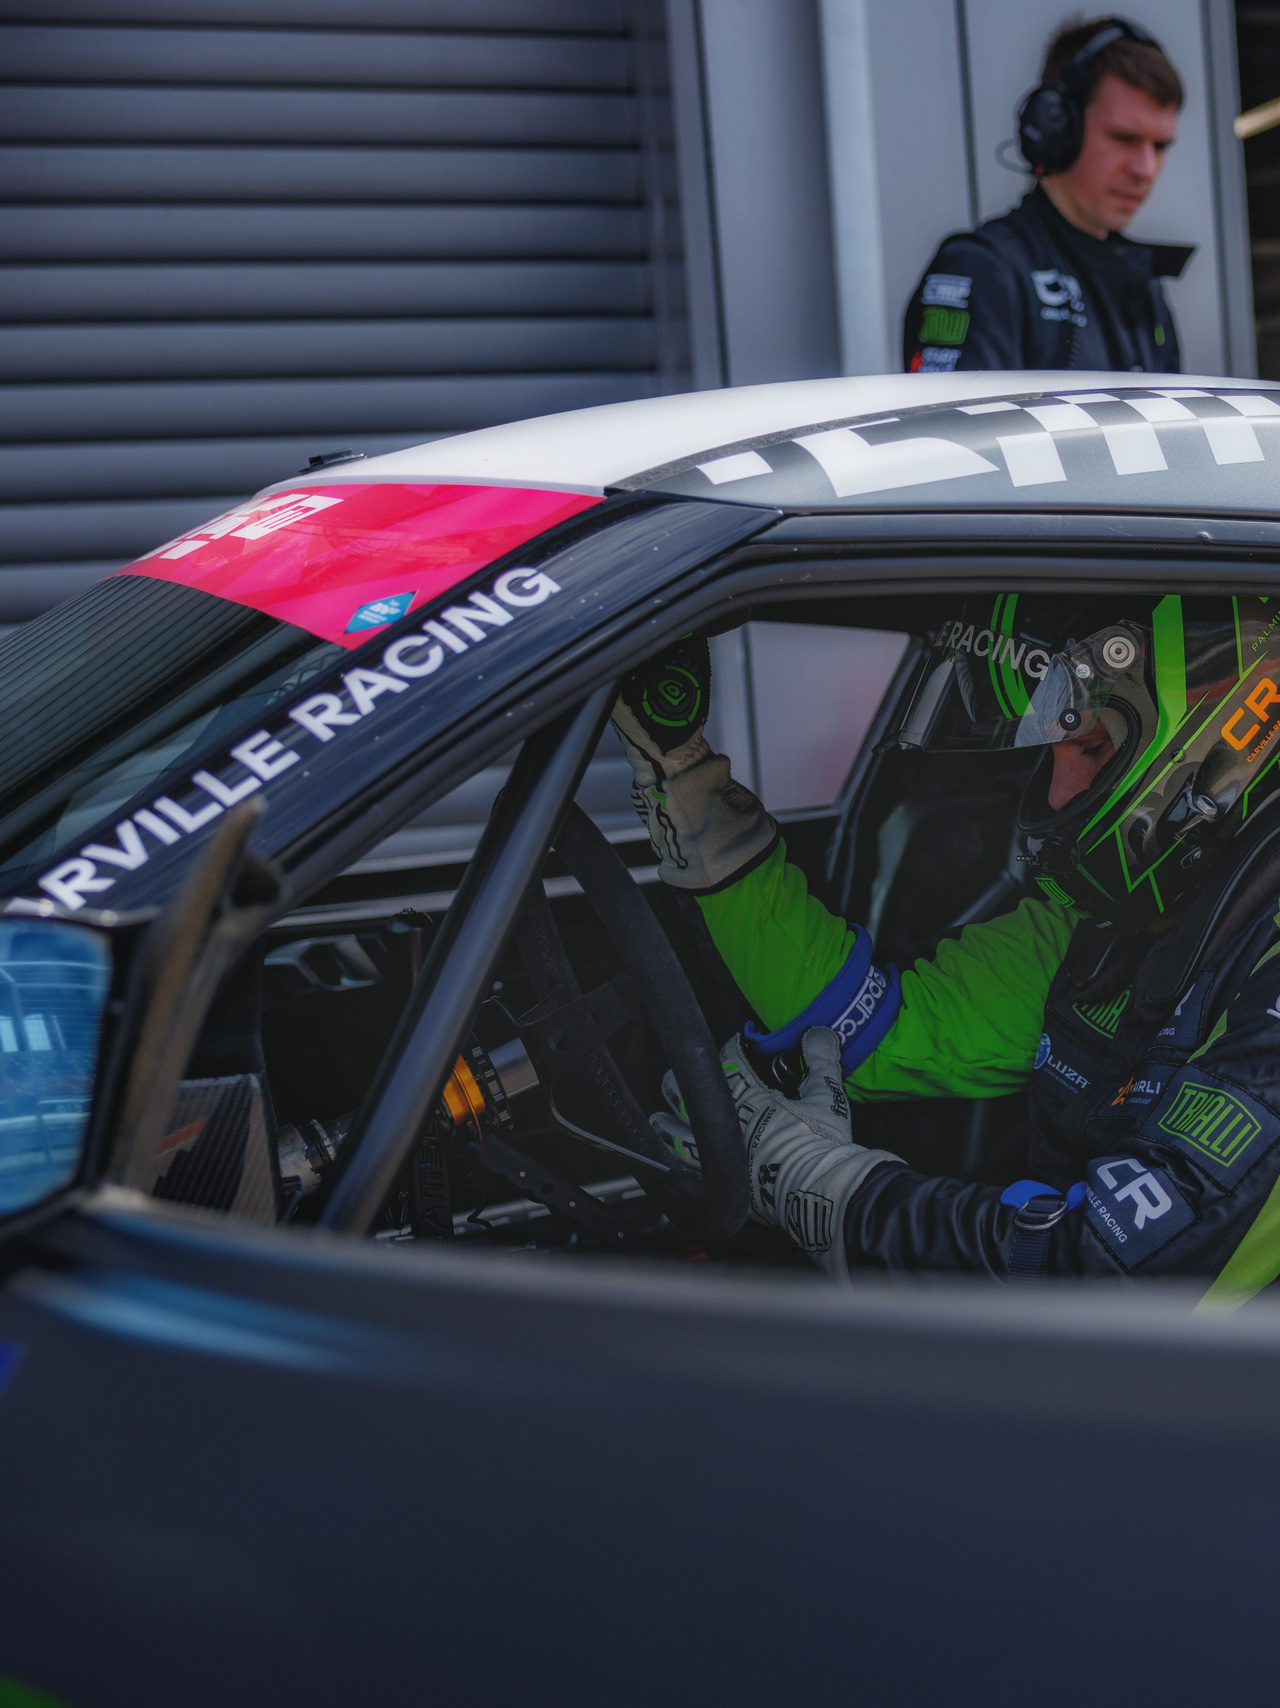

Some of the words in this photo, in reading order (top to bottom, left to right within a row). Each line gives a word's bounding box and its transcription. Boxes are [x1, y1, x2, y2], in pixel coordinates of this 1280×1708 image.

[947, 622, 1052, 682] RACING
[3, 731, 302, 912] RVILLE
[289, 566, 563, 743] RACING
[1246, 729, 1275, 763] CARVILLE
[1046, 1054, 1092, 1090] LUZA
[752, 1108, 777, 1149] RACING
[1166, 1088, 1254, 1159] TRIALLI
[1096, 1158, 1173, 1231] CR
[1098, 1206, 1128, 1244] RACING
